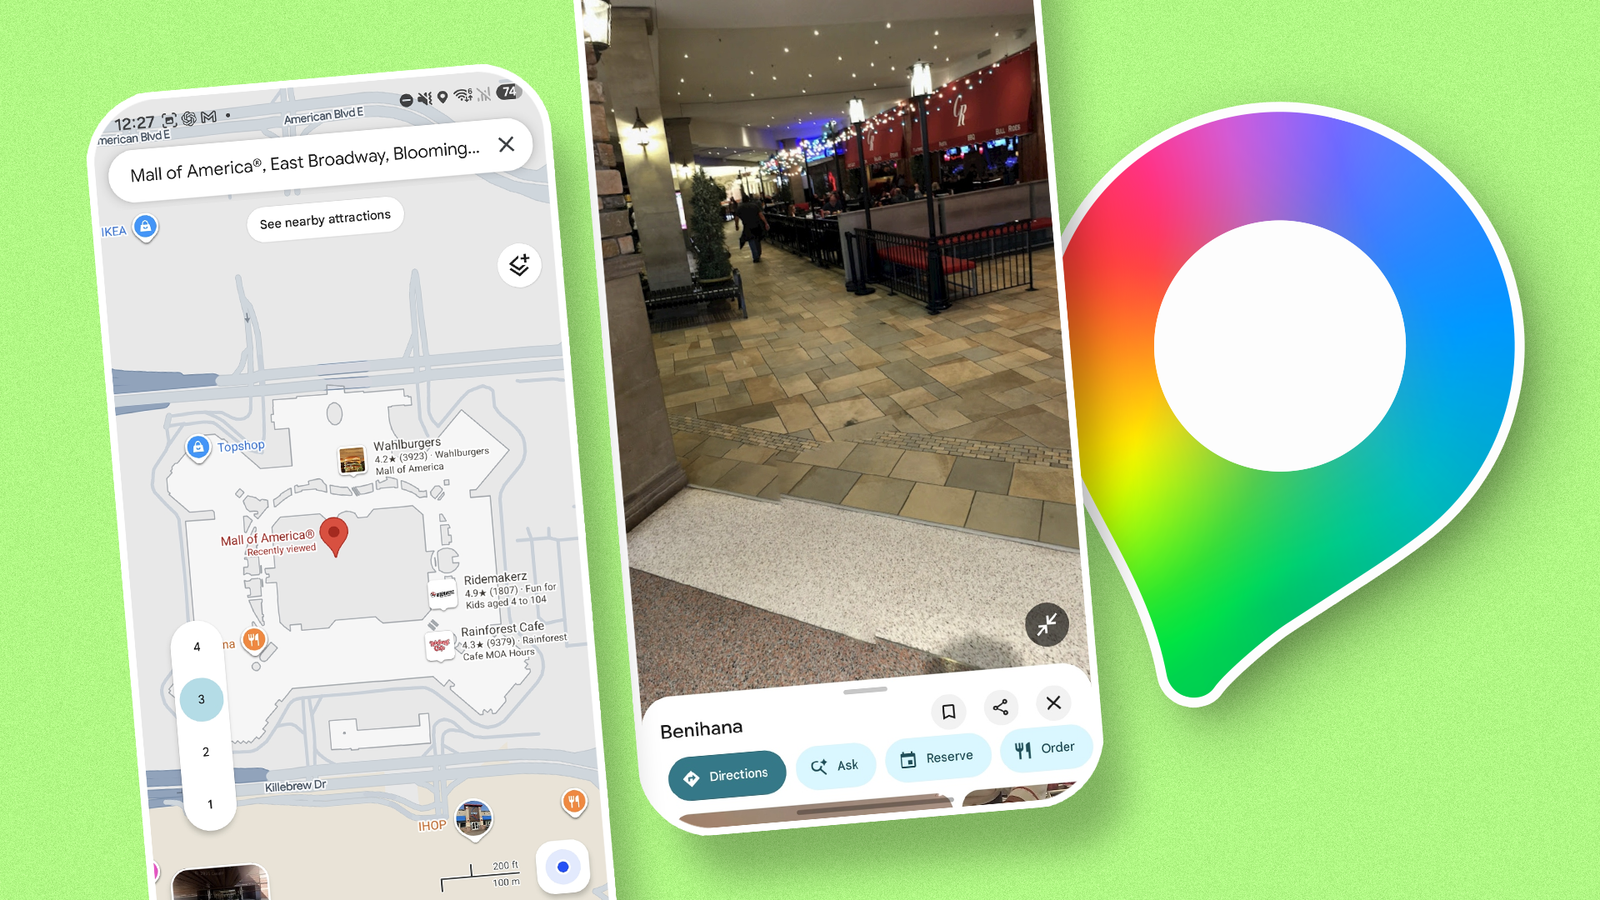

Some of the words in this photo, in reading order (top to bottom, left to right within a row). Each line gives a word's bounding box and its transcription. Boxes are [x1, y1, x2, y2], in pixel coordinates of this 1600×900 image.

[502, 86, 516, 97] 74
[284, 111, 332, 125] American
[334, 107, 356, 120] Blvd
[358, 106, 364, 117] E
[114, 115, 155, 131] 12:27
[97, 134, 139, 146] merican
[140, 130, 163, 142] Blvd
[164, 129, 171, 139] E
[130, 166, 162, 183] Mall
[166, 165, 183, 180] of
[270, 155, 304, 171] East
[308, 150, 389, 168] Broadway,
[260, 218, 282, 230] See
[285, 214, 325, 228] nearby
[328, 209, 391, 224] attractions
[101, 226, 127, 238] IKEA
[217, 440, 265, 452] Topshop
[373, 438, 442, 452] Wahlburgers
[399, 451, 428, 463] (3923)
[434, 447, 490, 459] Wahlburgers
[375, 467, 395, 476] Mall
[397, 465, 406, 474] of
[408, 463, 444, 473] America
[220, 535, 244, 547] Mall
[247, 532, 258, 544] of
[247, 546, 284, 558] Recently
[286, 542, 316, 554] viewed
[464, 572, 528, 586] Ridemakerz
[489, 585, 518, 597] (1807)
[525, 584, 542, 593] Fun
[544, 582, 557, 592] for
[466, 600, 485, 610] Kids
[488, 598, 509, 609] aged
[511, 597, 517, 605] 4
[519, 596, 528, 605] to
[530, 594, 547, 604] 104
[461, 622, 517, 637] Rainforest
[519, 621, 545, 632] Cafe
[193, 642, 201, 652] 4
[486, 636, 516, 649] (9379)
[522, 633, 568, 645] Rainforest
[463, 652, 484, 661] Cafe
[486, 650, 508, 660] MOA
[509, 648, 536, 658] Hours
[198, 694, 206, 705] 3
[660, 721, 743, 740] Benihana
[202, 746, 210, 757] 2
[1041, 742, 1076, 754] Order
[926, 750, 974, 764] Reserve
[837, 759, 859, 771] Ask
[709, 767, 769, 782] Directions
[264, 779, 312, 793] Killebrew
[314, 779, 327, 790] Dr
[207, 799, 213, 810] 1
[418, 820, 448, 832] IHOP
[492, 861, 510, 871] 200
[512, 860, 519, 870] ft
[492, 878, 510, 888] 100
[512, 878, 520, 886] m
